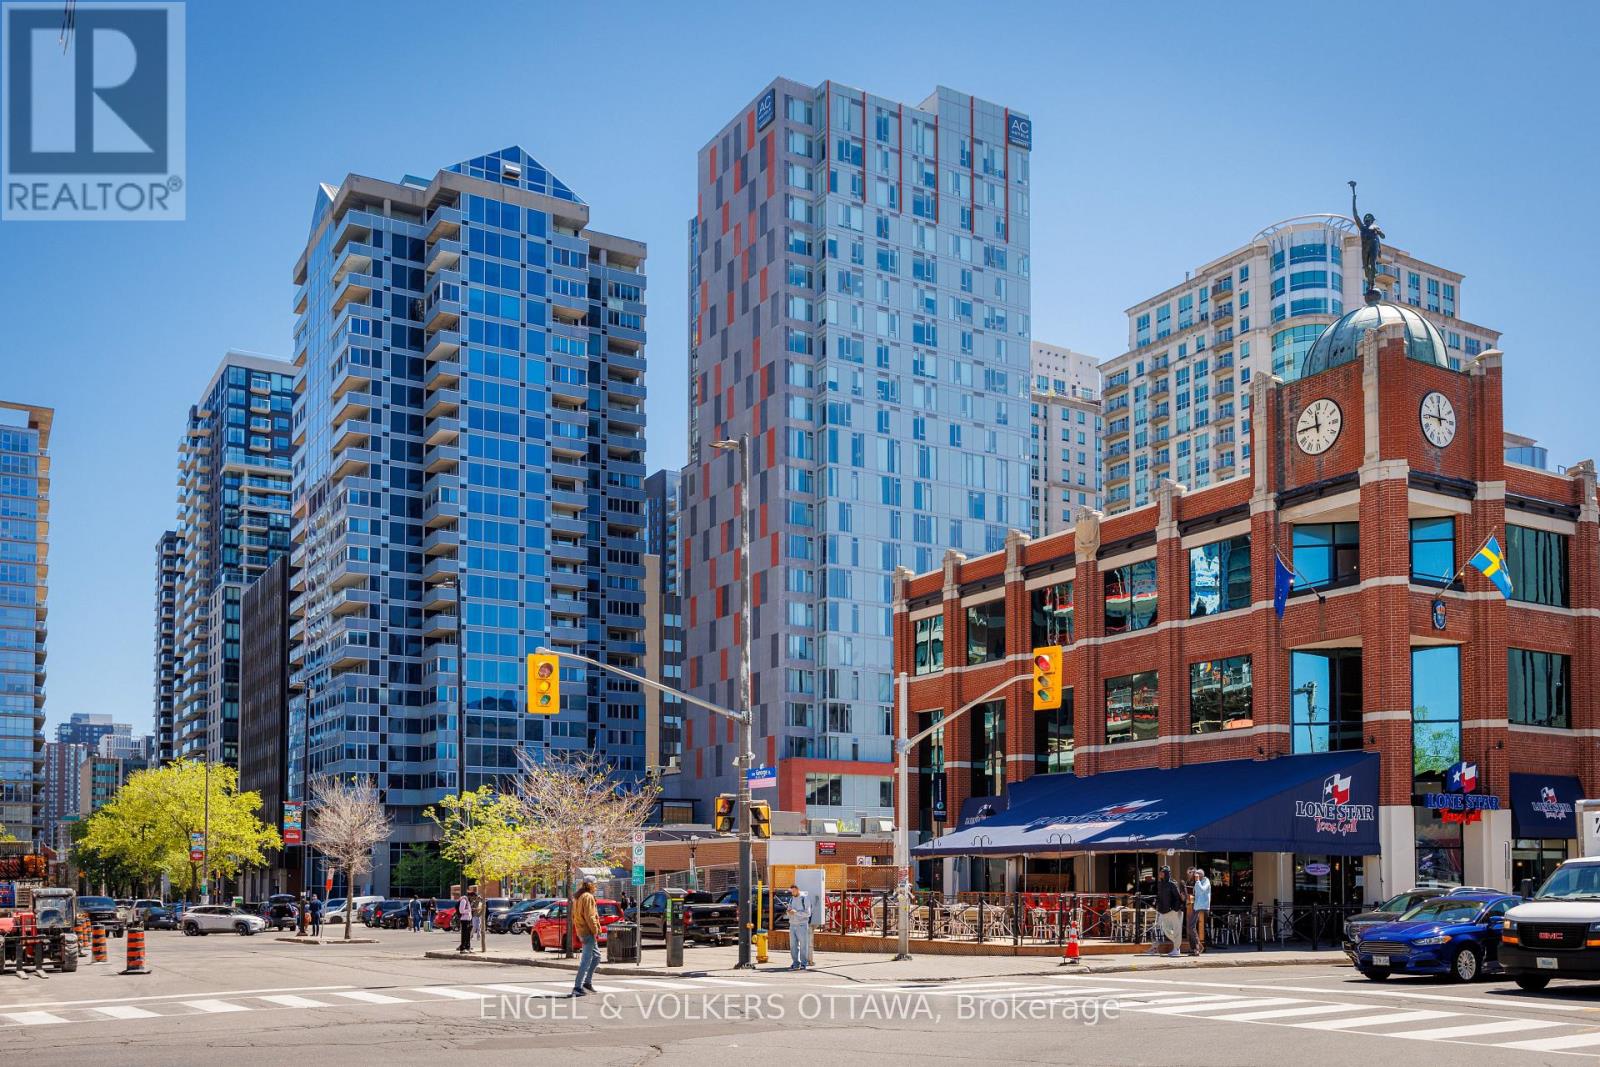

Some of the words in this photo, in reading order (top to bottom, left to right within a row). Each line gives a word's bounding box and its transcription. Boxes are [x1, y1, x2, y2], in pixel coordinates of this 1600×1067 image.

[1011, 119, 1029, 134] AC
[1425, 793, 1464, 809] LONE
[1465, 794, 1500, 810] STAR
[1295, 800, 1335, 820] LONE
[1337, 804, 1375, 821] STAR
[1314, 816, 1337, 834] Texas
[1337, 818, 1359, 837] Grill
[1539, 932, 1564, 940] GMC
